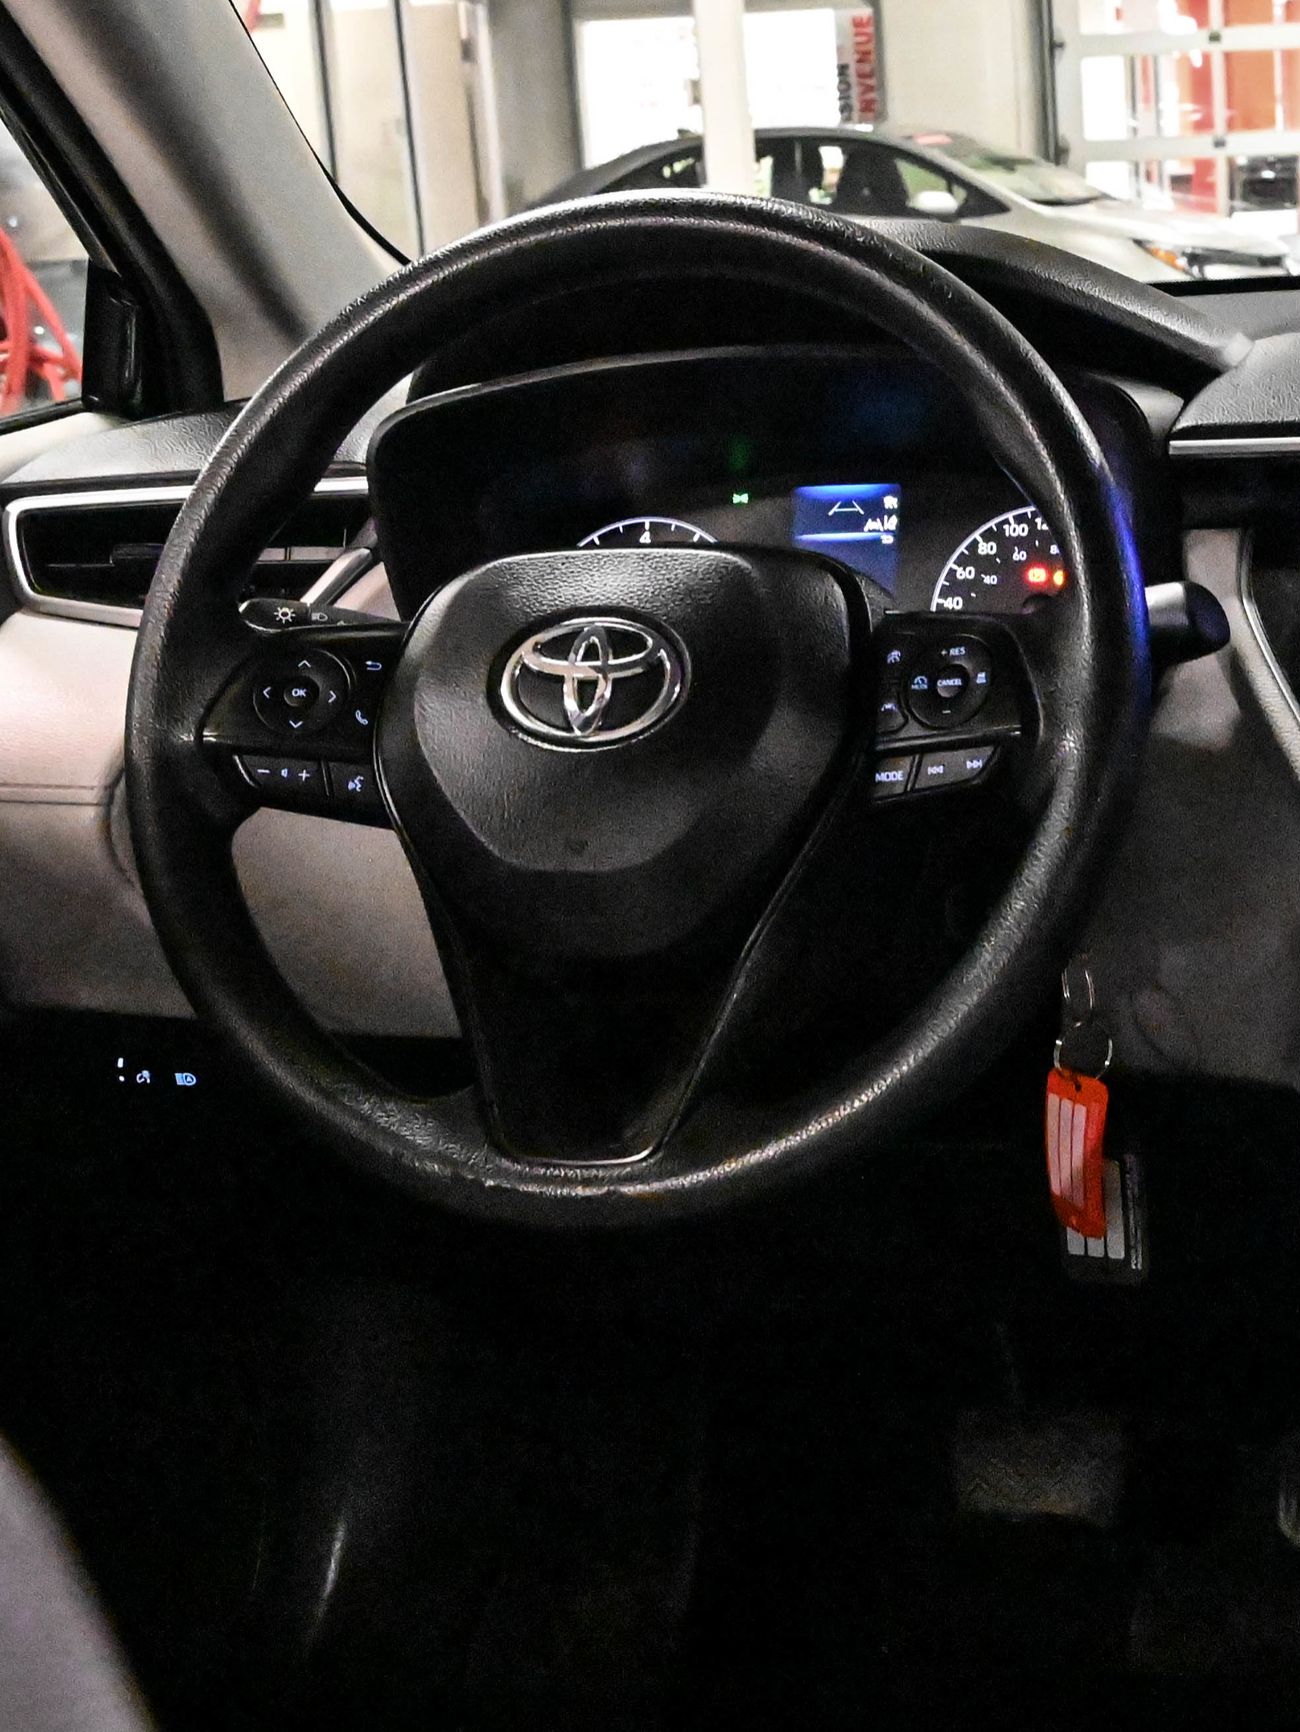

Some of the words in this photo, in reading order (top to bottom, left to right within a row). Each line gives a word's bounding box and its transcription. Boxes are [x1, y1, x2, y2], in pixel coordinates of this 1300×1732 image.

[1002, 523, 1029, 537] 100
[639, 531, 651, 544] 4
[977, 541, 997, 555] 80
[1012, 550, 1027, 561] 60
[956, 566, 975, 580] 60
[983, 575, 998, 585] 40
[943, 596, 963, 610] 40
[937, 678, 962, 687] CANCEL
[291, 688, 308, 698] OK
[875, 770, 904, 782] MODE
